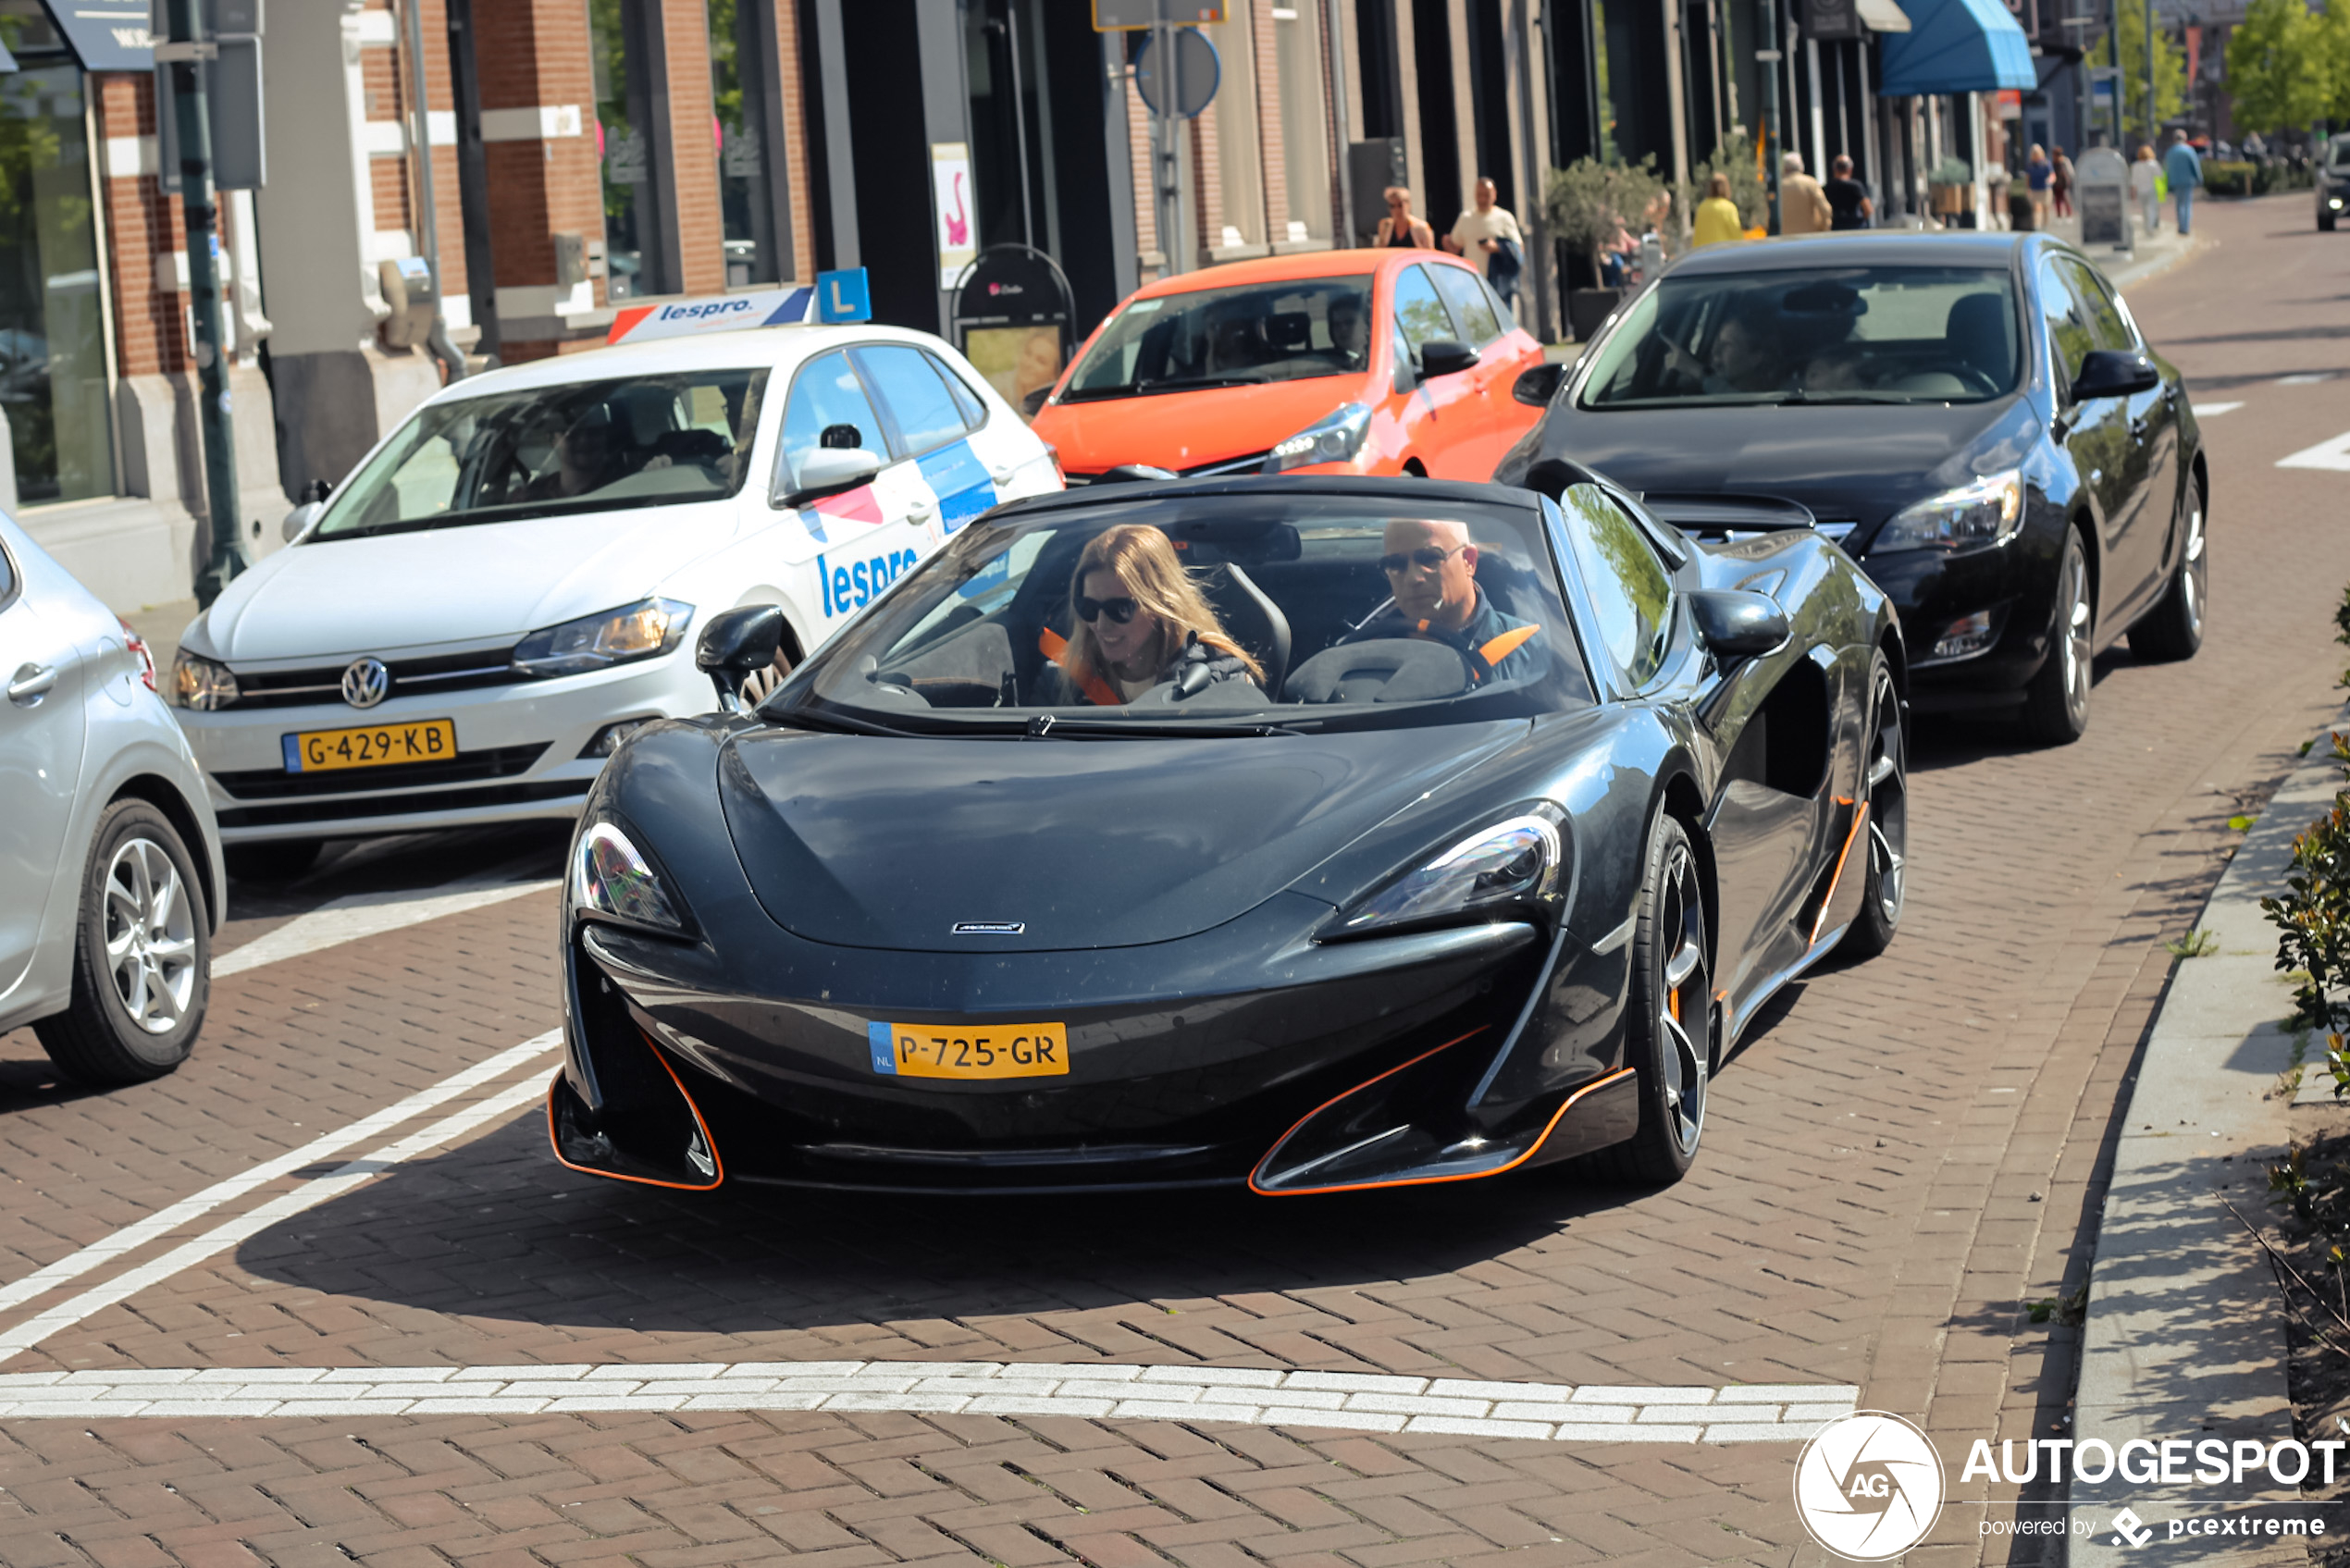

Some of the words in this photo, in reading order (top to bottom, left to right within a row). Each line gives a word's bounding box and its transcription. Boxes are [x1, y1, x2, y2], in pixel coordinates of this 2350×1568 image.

[660, 300, 753, 321] lespro.
[830, 279, 856, 314] L
[308, 727, 443, 764] G-429-KB
[876, 1056, 893, 1067] NL
[900, 1036, 1057, 1067] P-725-GR
